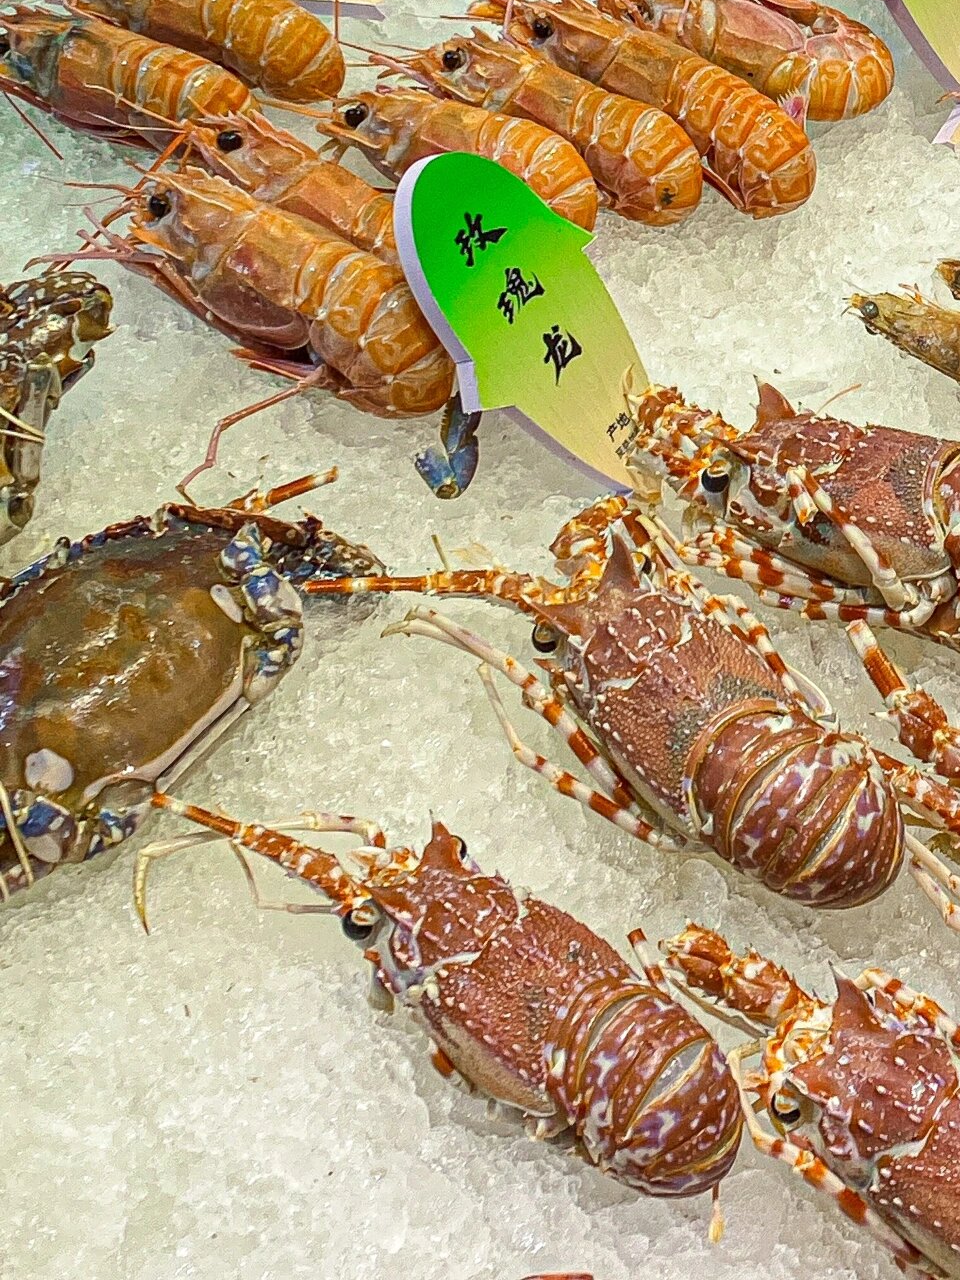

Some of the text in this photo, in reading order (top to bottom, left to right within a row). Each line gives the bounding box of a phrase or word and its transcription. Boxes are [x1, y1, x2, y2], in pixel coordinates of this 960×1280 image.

[454, 211, 583, 386] 玫瑰龙
[606, 412, 630, 443] 产地
